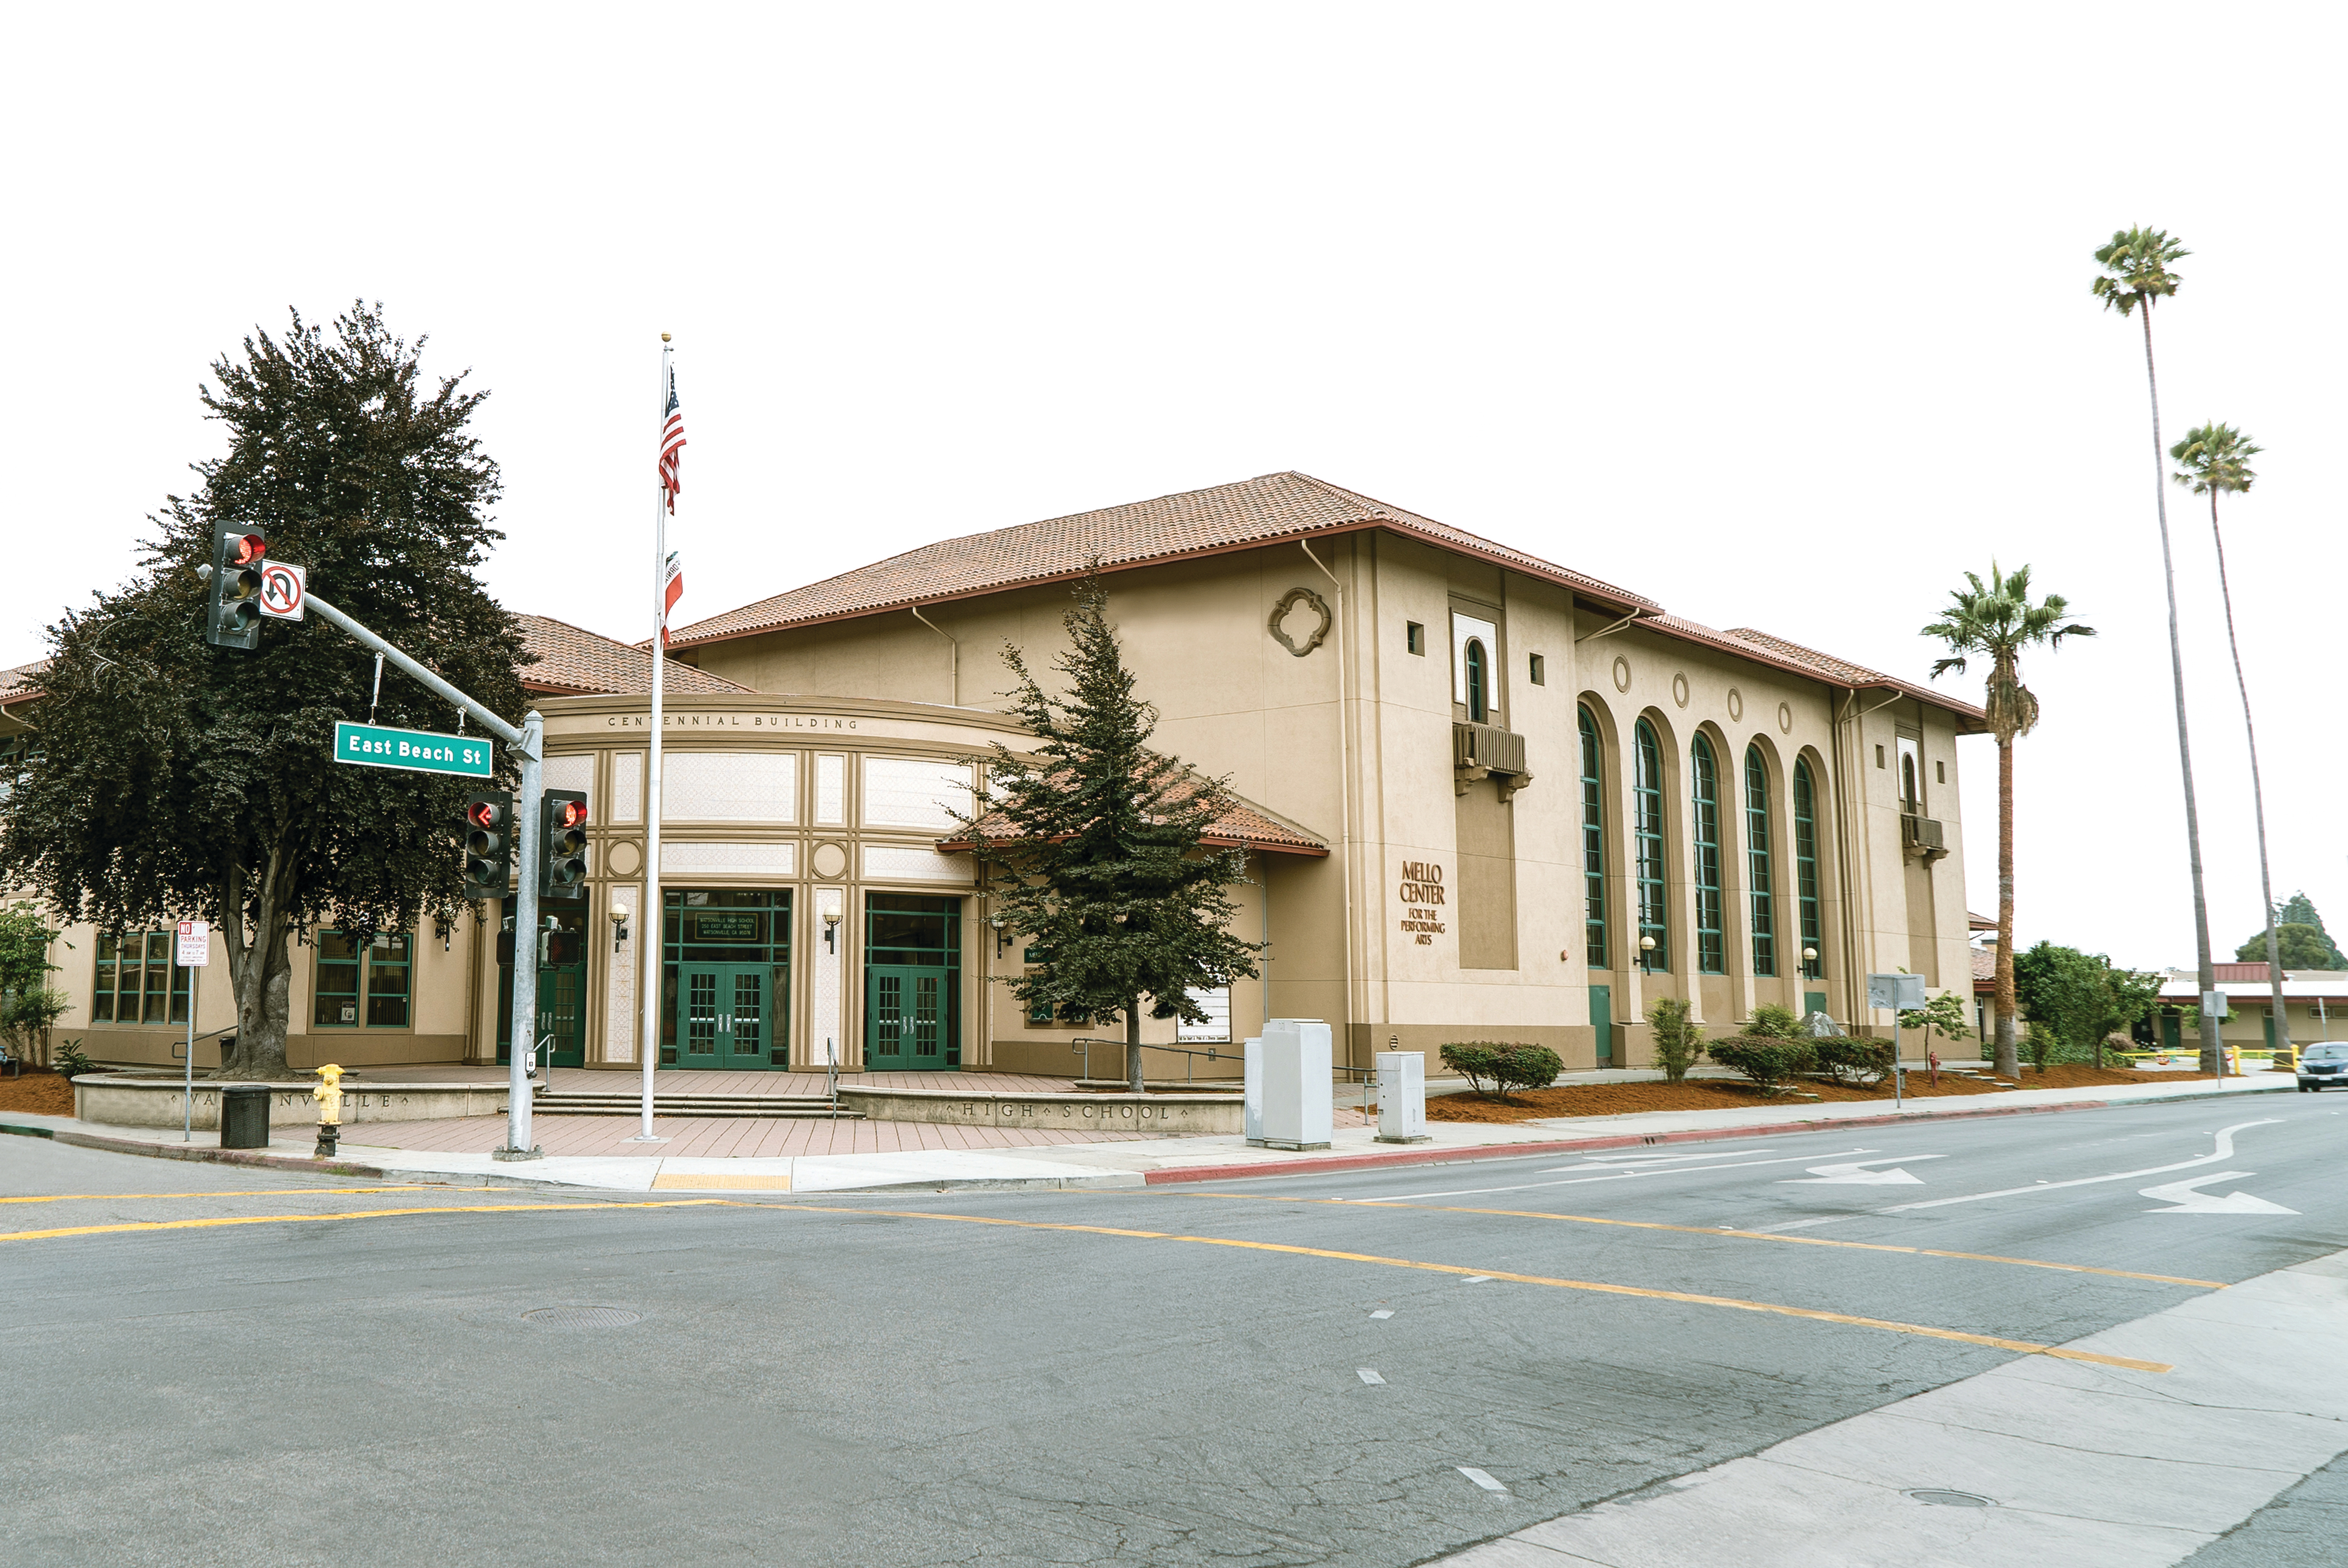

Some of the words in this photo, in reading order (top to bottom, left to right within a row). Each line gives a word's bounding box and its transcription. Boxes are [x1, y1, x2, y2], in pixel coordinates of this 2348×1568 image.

[608, 716, 739, 726] CENENNIAL
[755, 718, 857, 729] BUILDING
[349, 735, 392, 755] East
[399, 741, 454, 762] Beach
[462, 748, 481, 765] St
[1402, 860, 1443, 884] MELLO
[1399, 882, 1446, 905] CENTER
[1409, 908, 1423, 919] FOR
[1423, 909, 1437, 921] THE
[180, 924, 191, 934] NO
[1401, 920, 1446, 934] PERFORMING
[1415, 934, 1432, 945] ARTS
[184, 1093, 390, 1107] WANVLLE
[962, 1103, 1033, 1117] HIGH
[1063, 1105, 1169, 1119] SCHOOL
